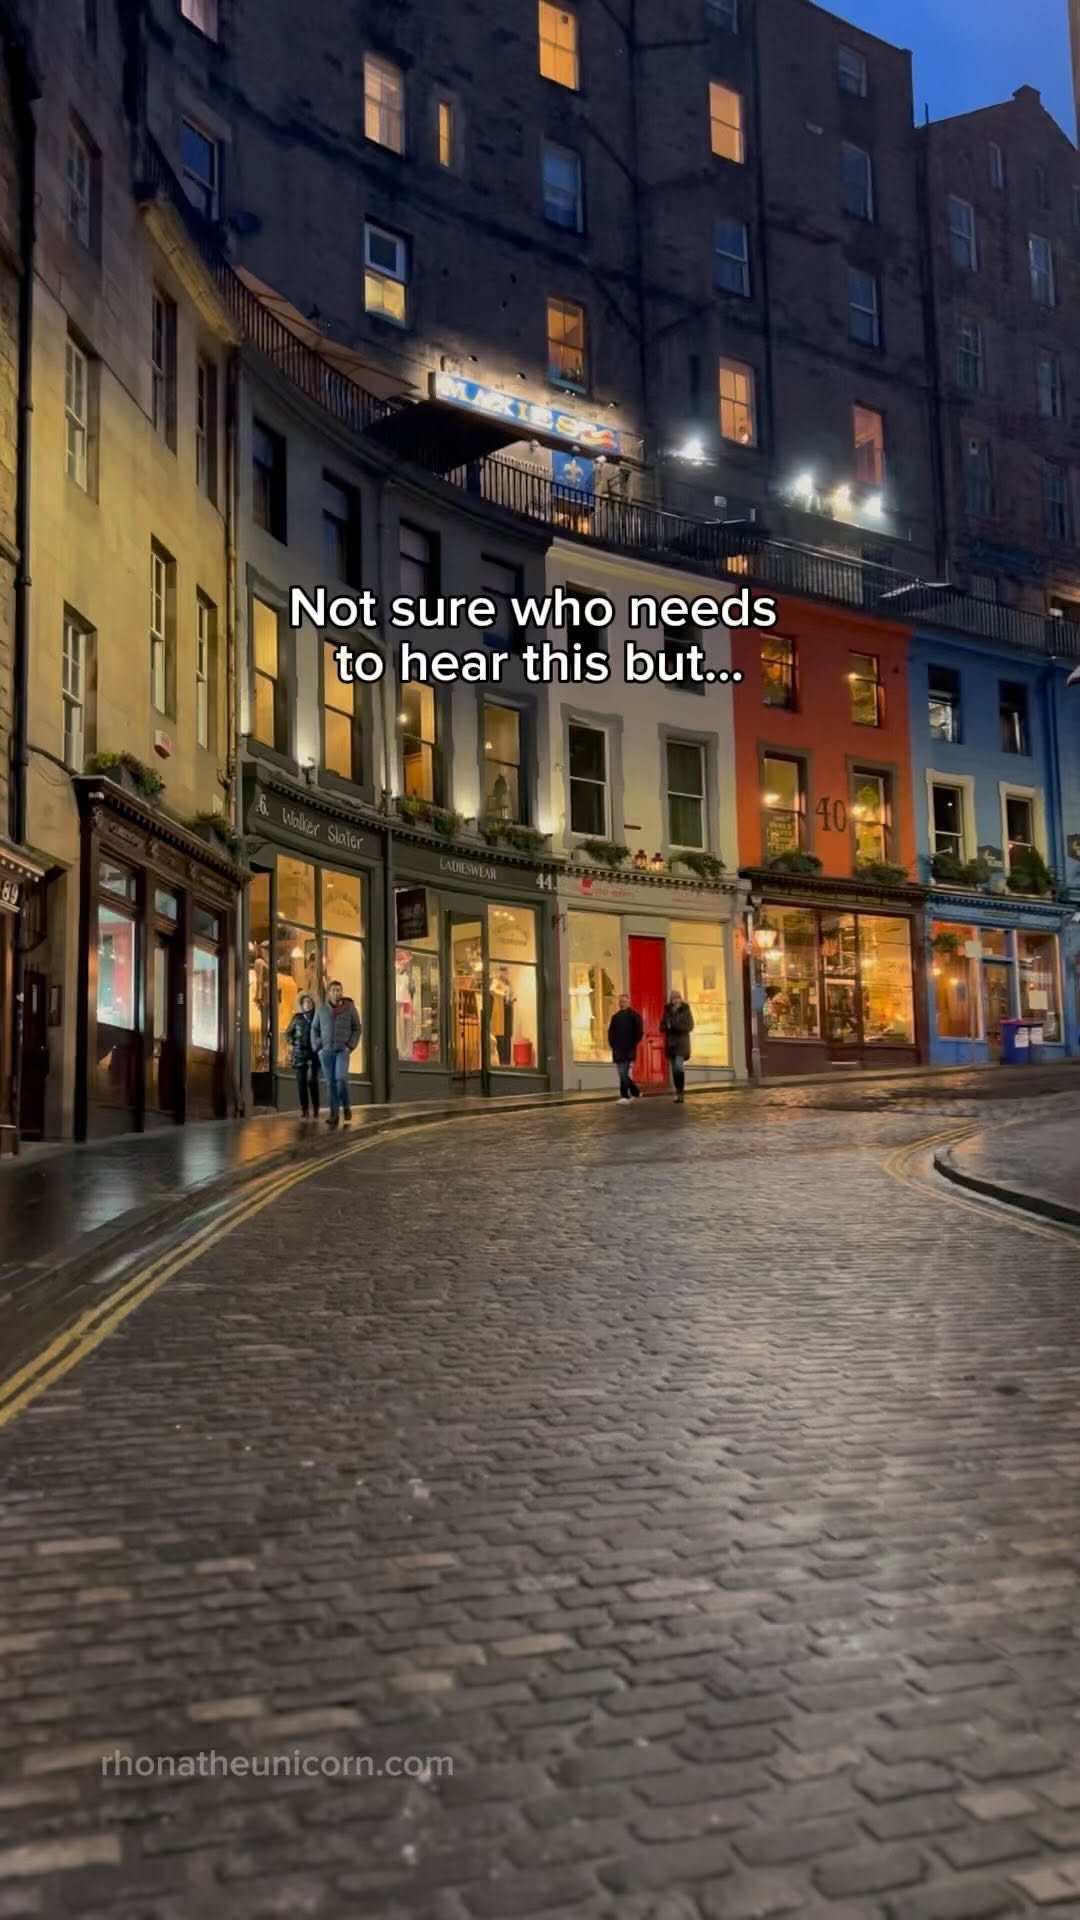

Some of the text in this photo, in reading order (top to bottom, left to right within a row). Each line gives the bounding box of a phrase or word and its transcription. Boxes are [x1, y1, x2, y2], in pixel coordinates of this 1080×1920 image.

[282, 807, 320, 837] Walker
[815, 795, 848, 833] 40
[439, 855, 497, 881] LADIESWEAR
